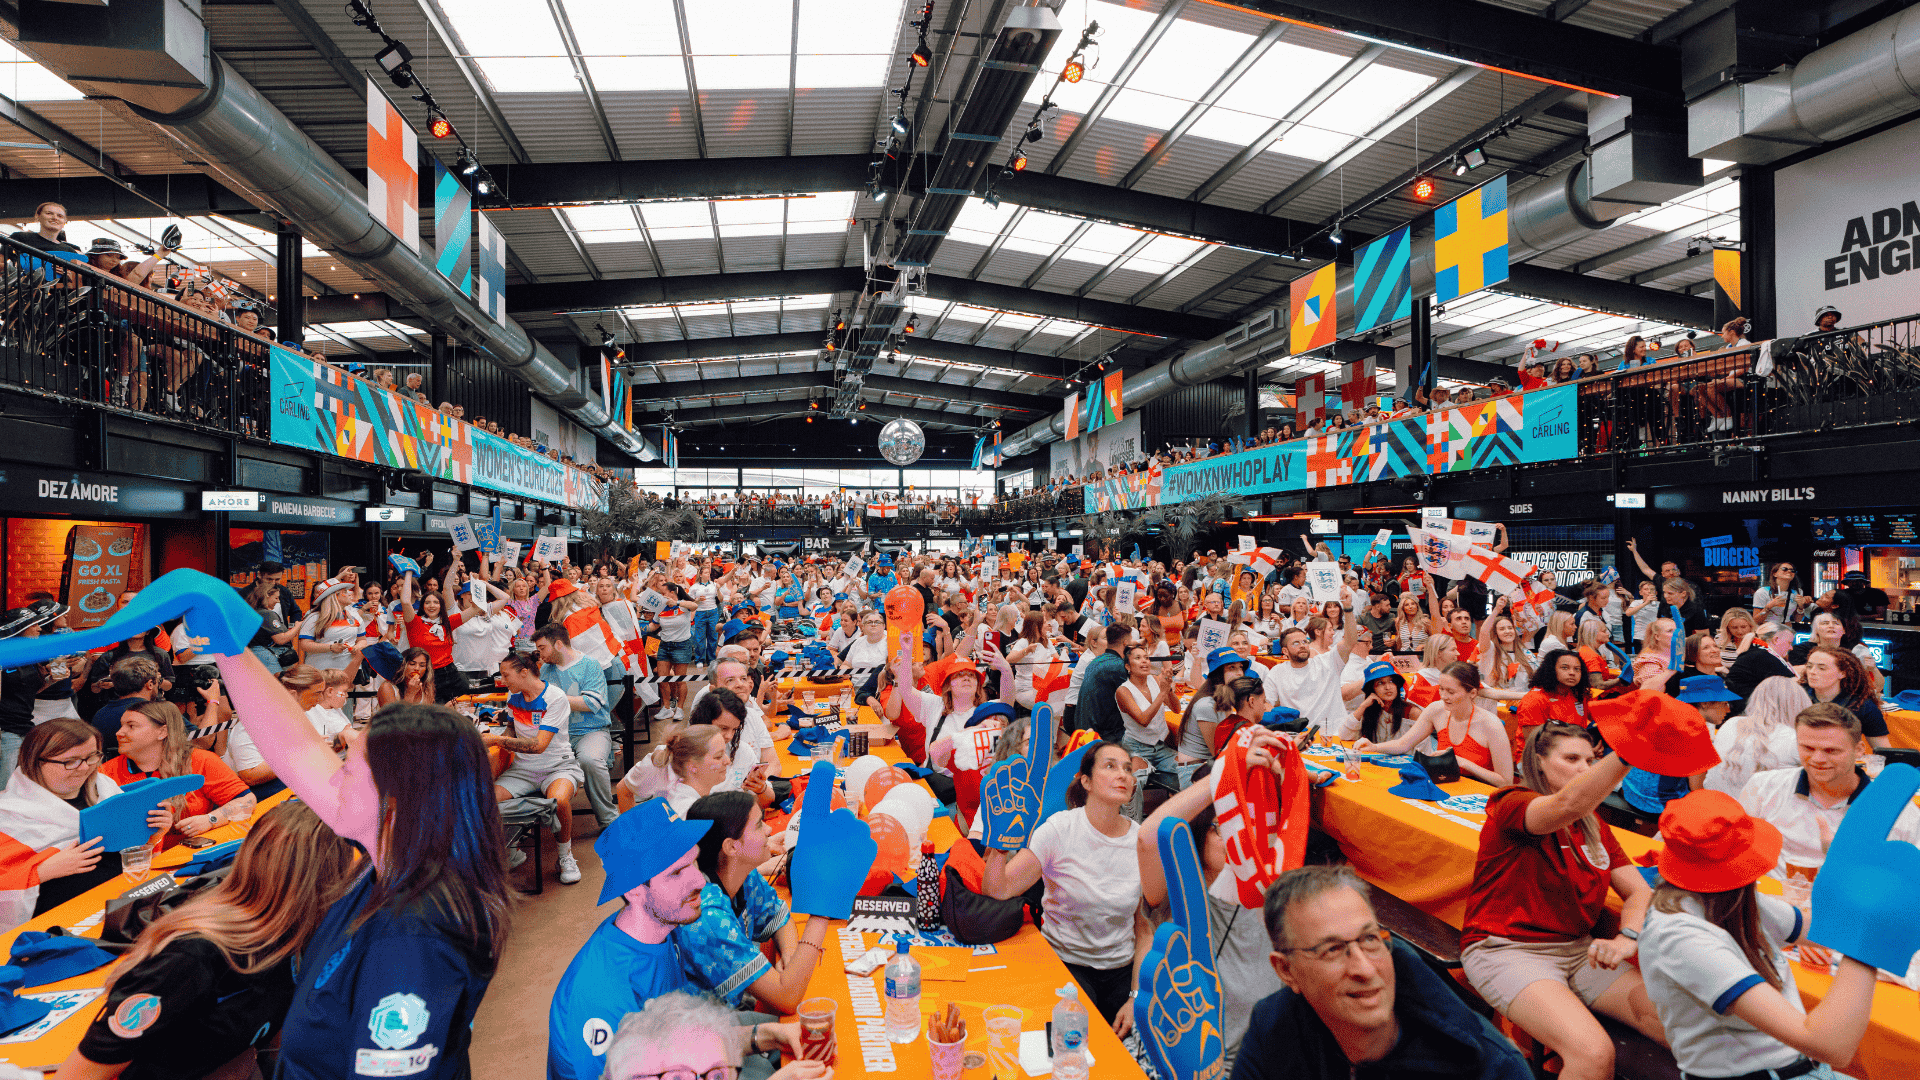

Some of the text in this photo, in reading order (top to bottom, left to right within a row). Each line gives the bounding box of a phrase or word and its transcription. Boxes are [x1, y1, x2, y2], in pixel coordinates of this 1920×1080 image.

[280, 398, 310, 421] CARLING
[1532, 421, 1570, 439] CARLING
[474, 440, 563, 496] WOMEN'S EURO 2025
[1168, 452, 1293, 497] #WOMXNWHOPLAY
[38, 479, 118, 502] DEZ AMORE
[1722, 487, 1815, 504] NANNY BILL'S
[208, 498, 250, 506] AMORE
[271, 501, 337, 519] IPANEMA BARBECUE
[1509, 504, 1533, 514] SIDES
[804, 537, 830, 549] BAR
[1510, 551, 1589, 570] WHICH SIDE
[1704, 547, 1760, 567] BURGERS
[78, 564, 122, 577] GO XL
[815, 714, 838, 724] RESERVED
[854, 899, 911, 913] RESERVED
[855, 1017, 897, 1073] PARTNER
